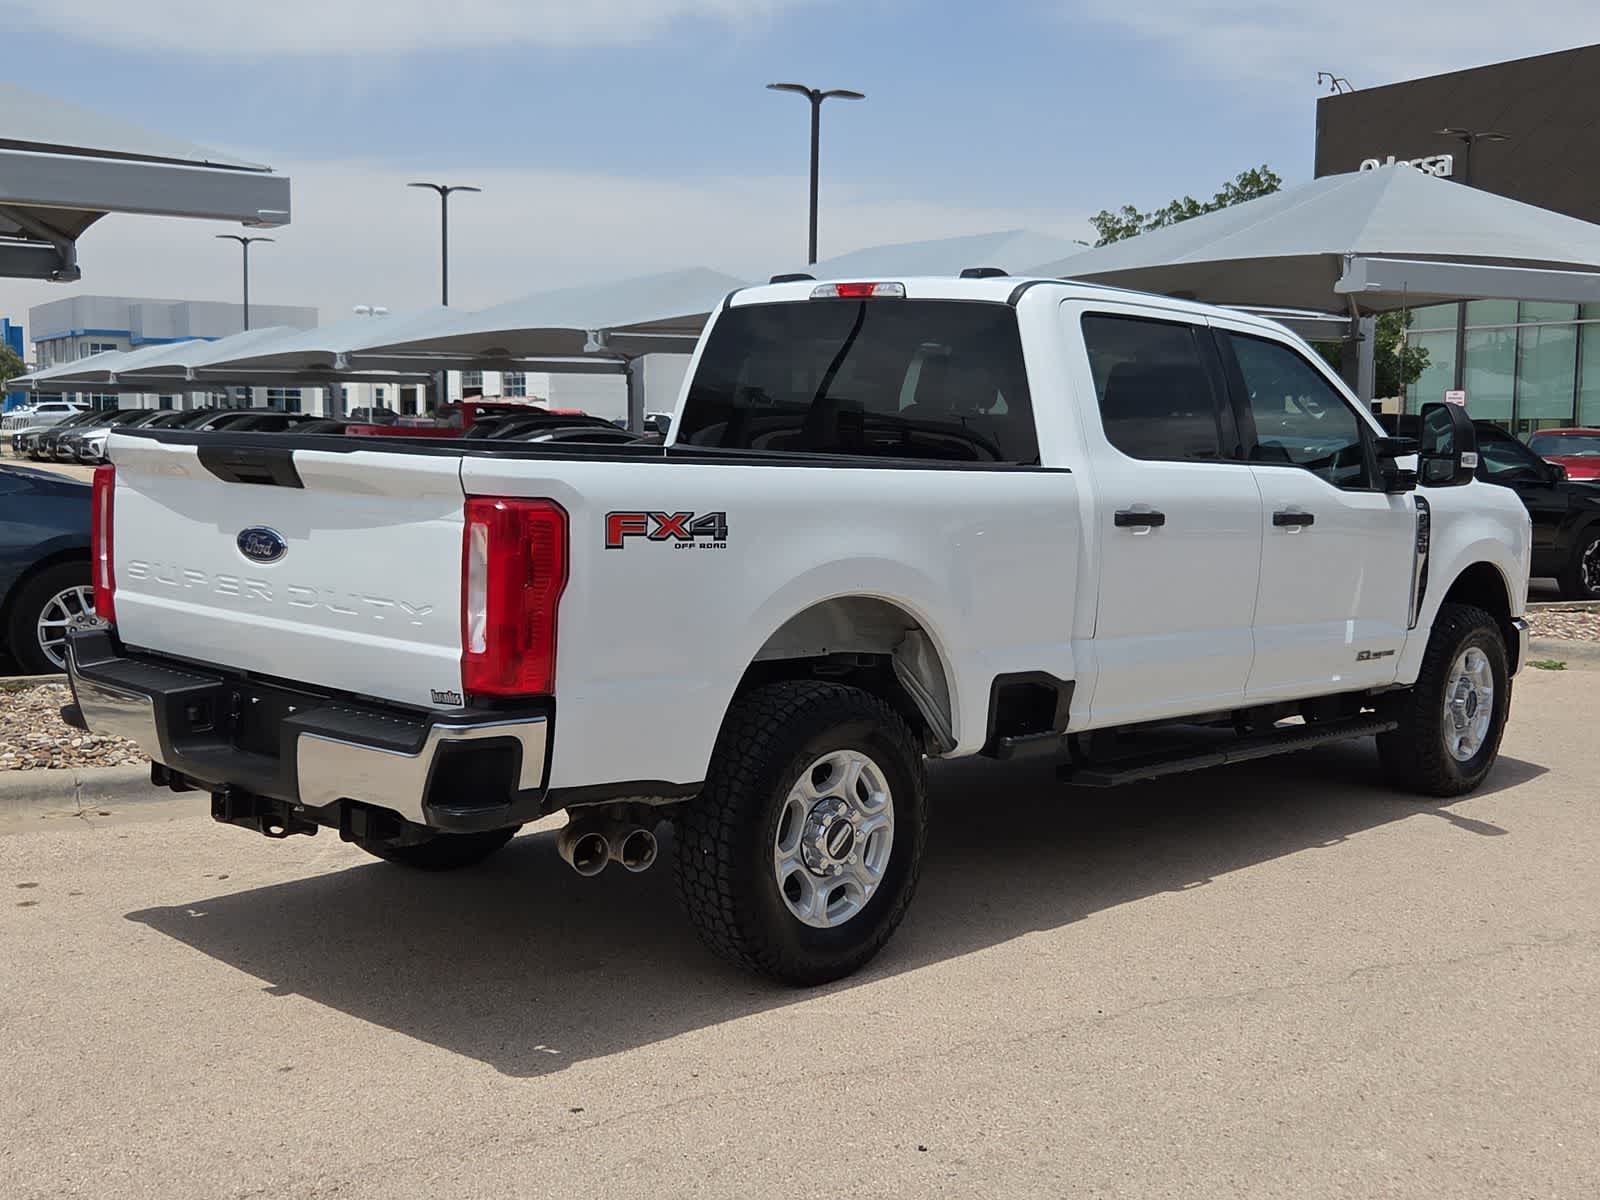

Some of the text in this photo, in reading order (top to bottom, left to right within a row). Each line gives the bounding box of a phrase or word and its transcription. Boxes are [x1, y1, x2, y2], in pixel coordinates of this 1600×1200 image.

[605, 511, 728, 549] FX4
[127, 559, 433, 626] SUPER DUTY
